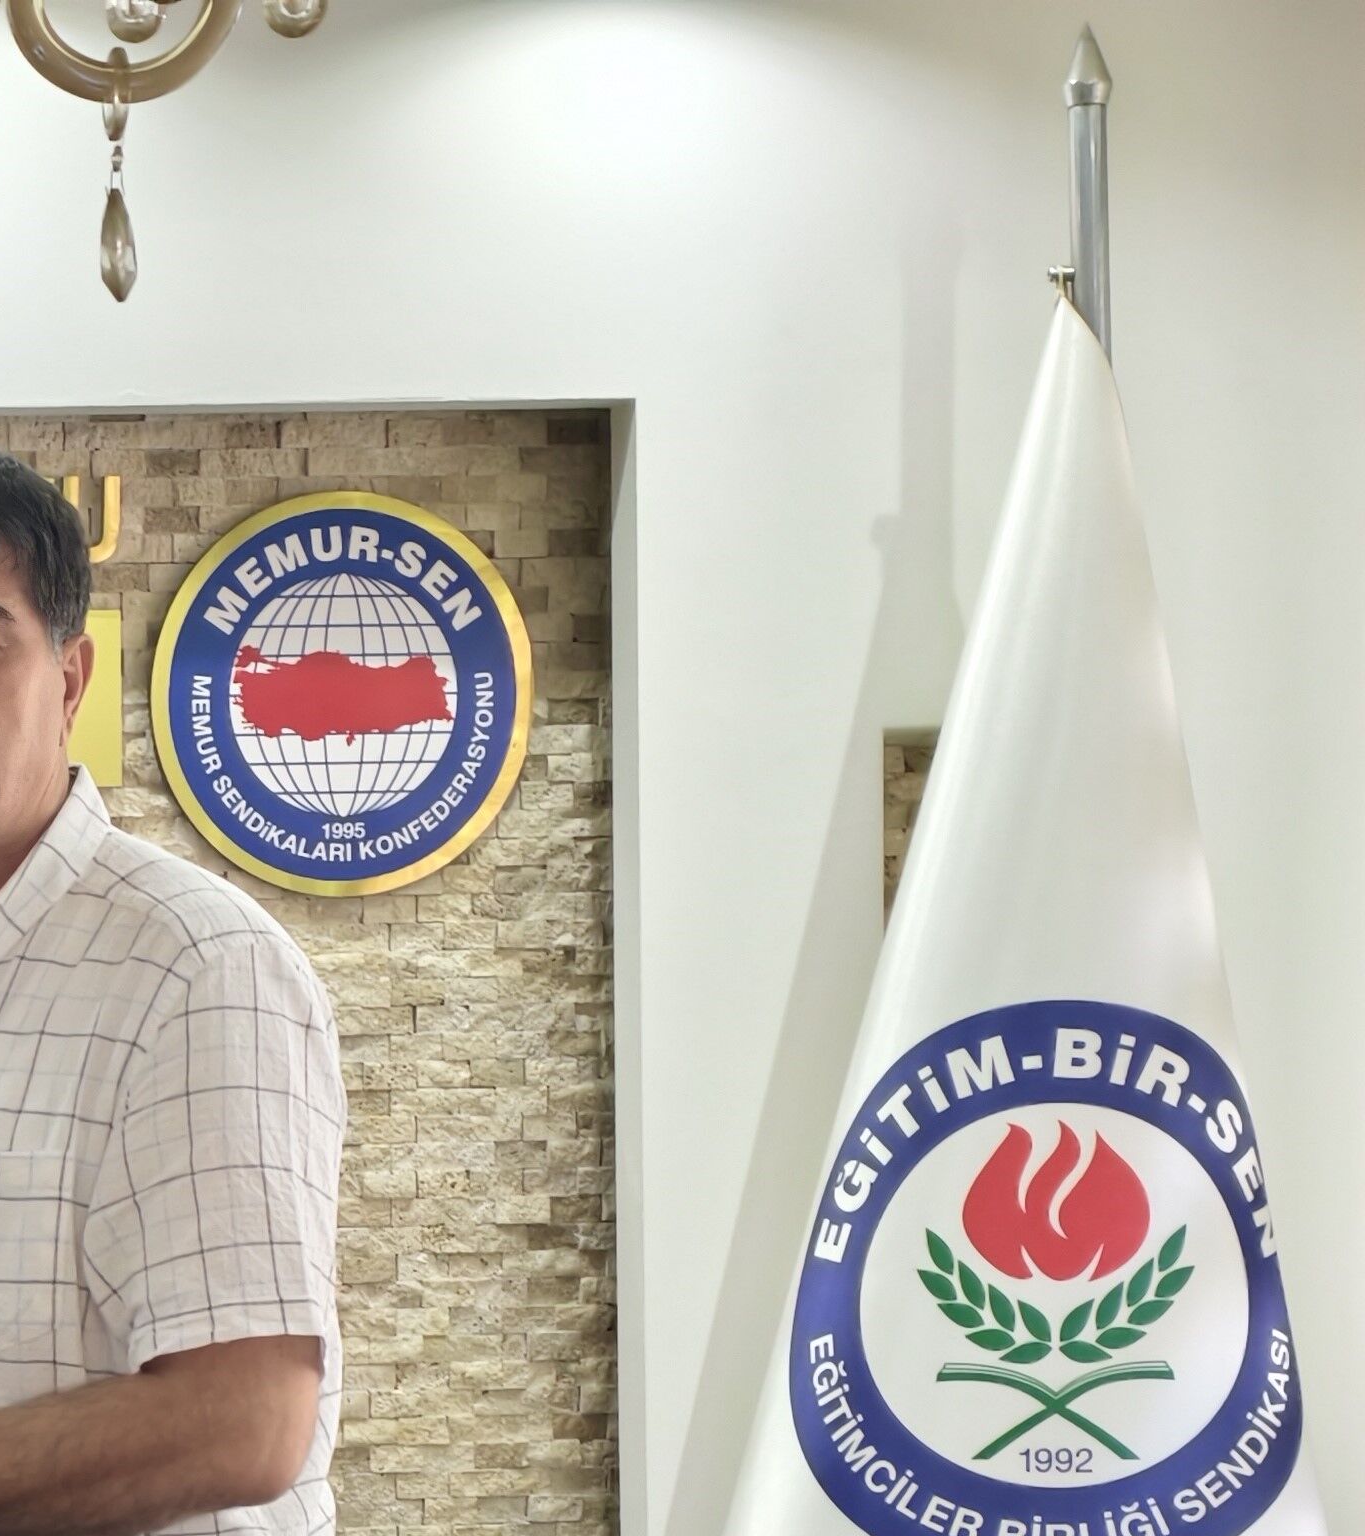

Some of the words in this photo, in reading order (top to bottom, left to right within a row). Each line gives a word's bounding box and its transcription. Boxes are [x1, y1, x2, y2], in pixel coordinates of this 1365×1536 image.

[202, 525, 483, 636] MEMUR-SEN
[190, 674, 223, 776] MEMUR
[358, 671, 495, 861] KONFEDERASYONU
[321, 822, 366, 840] 1995
[1018, 1447, 1094, 1474] 1992
[1179, 1328, 1291, 1524] SENDİKASI
